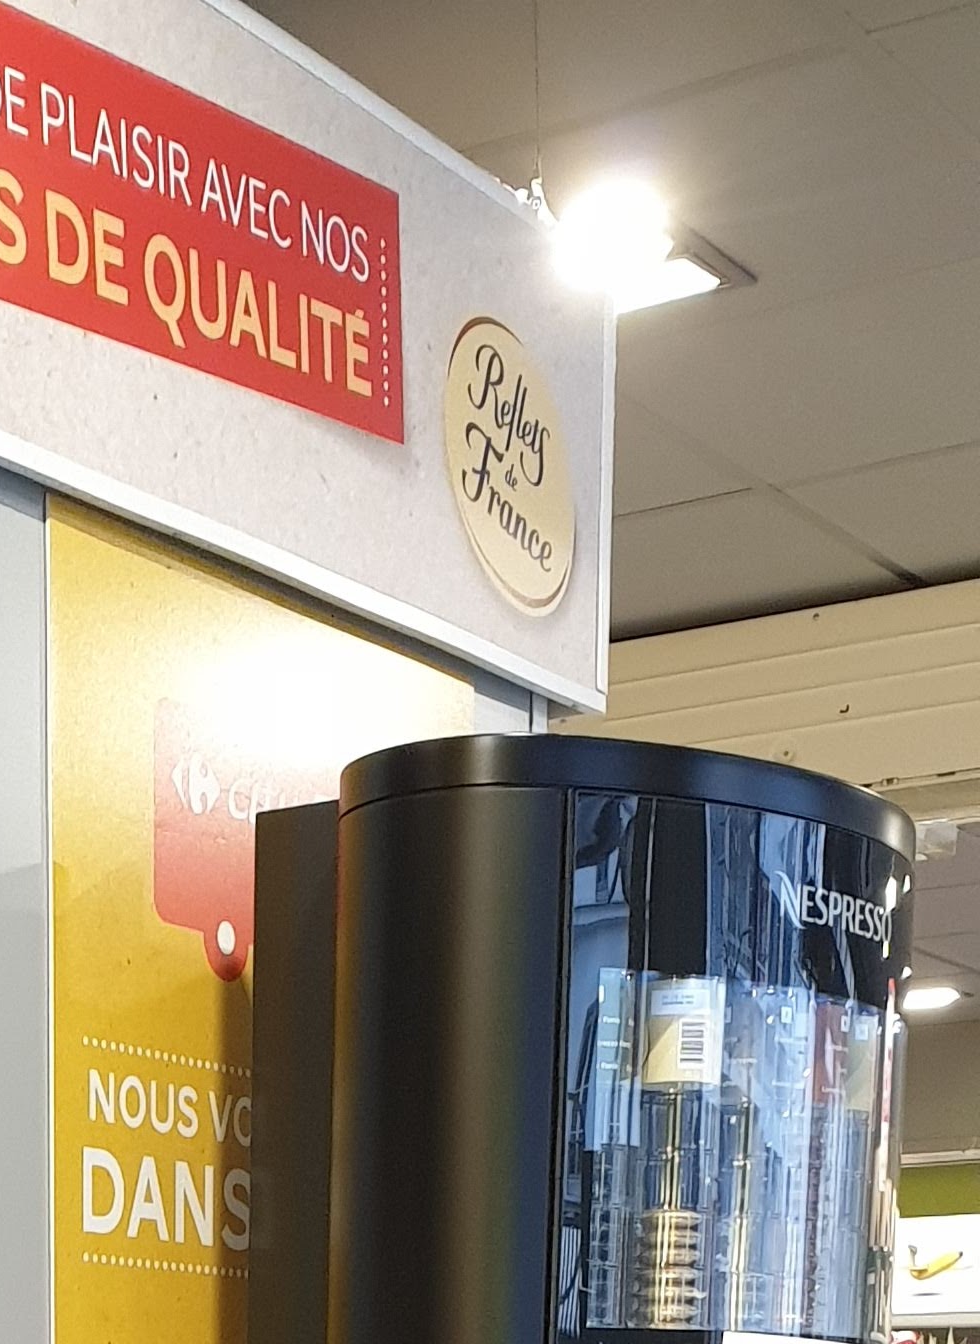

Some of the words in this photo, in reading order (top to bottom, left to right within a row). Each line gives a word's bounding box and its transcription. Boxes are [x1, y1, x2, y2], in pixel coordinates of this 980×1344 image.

[39, 81, 193, 207] PLAISIR
[200, 156, 293, 250] AVEC
[300, 200, 371, 283] NOS
[44, 188, 130, 307] DE
[142, 232, 374, 398] QUALITÉ
[461, 421, 553, 573] France
[504, 463, 519, 492] de
[773, 869, 892, 943] NESPRESSO
[88, 1068, 200, 1139] NOUS
[82, 1145, 251, 1251] DANS
